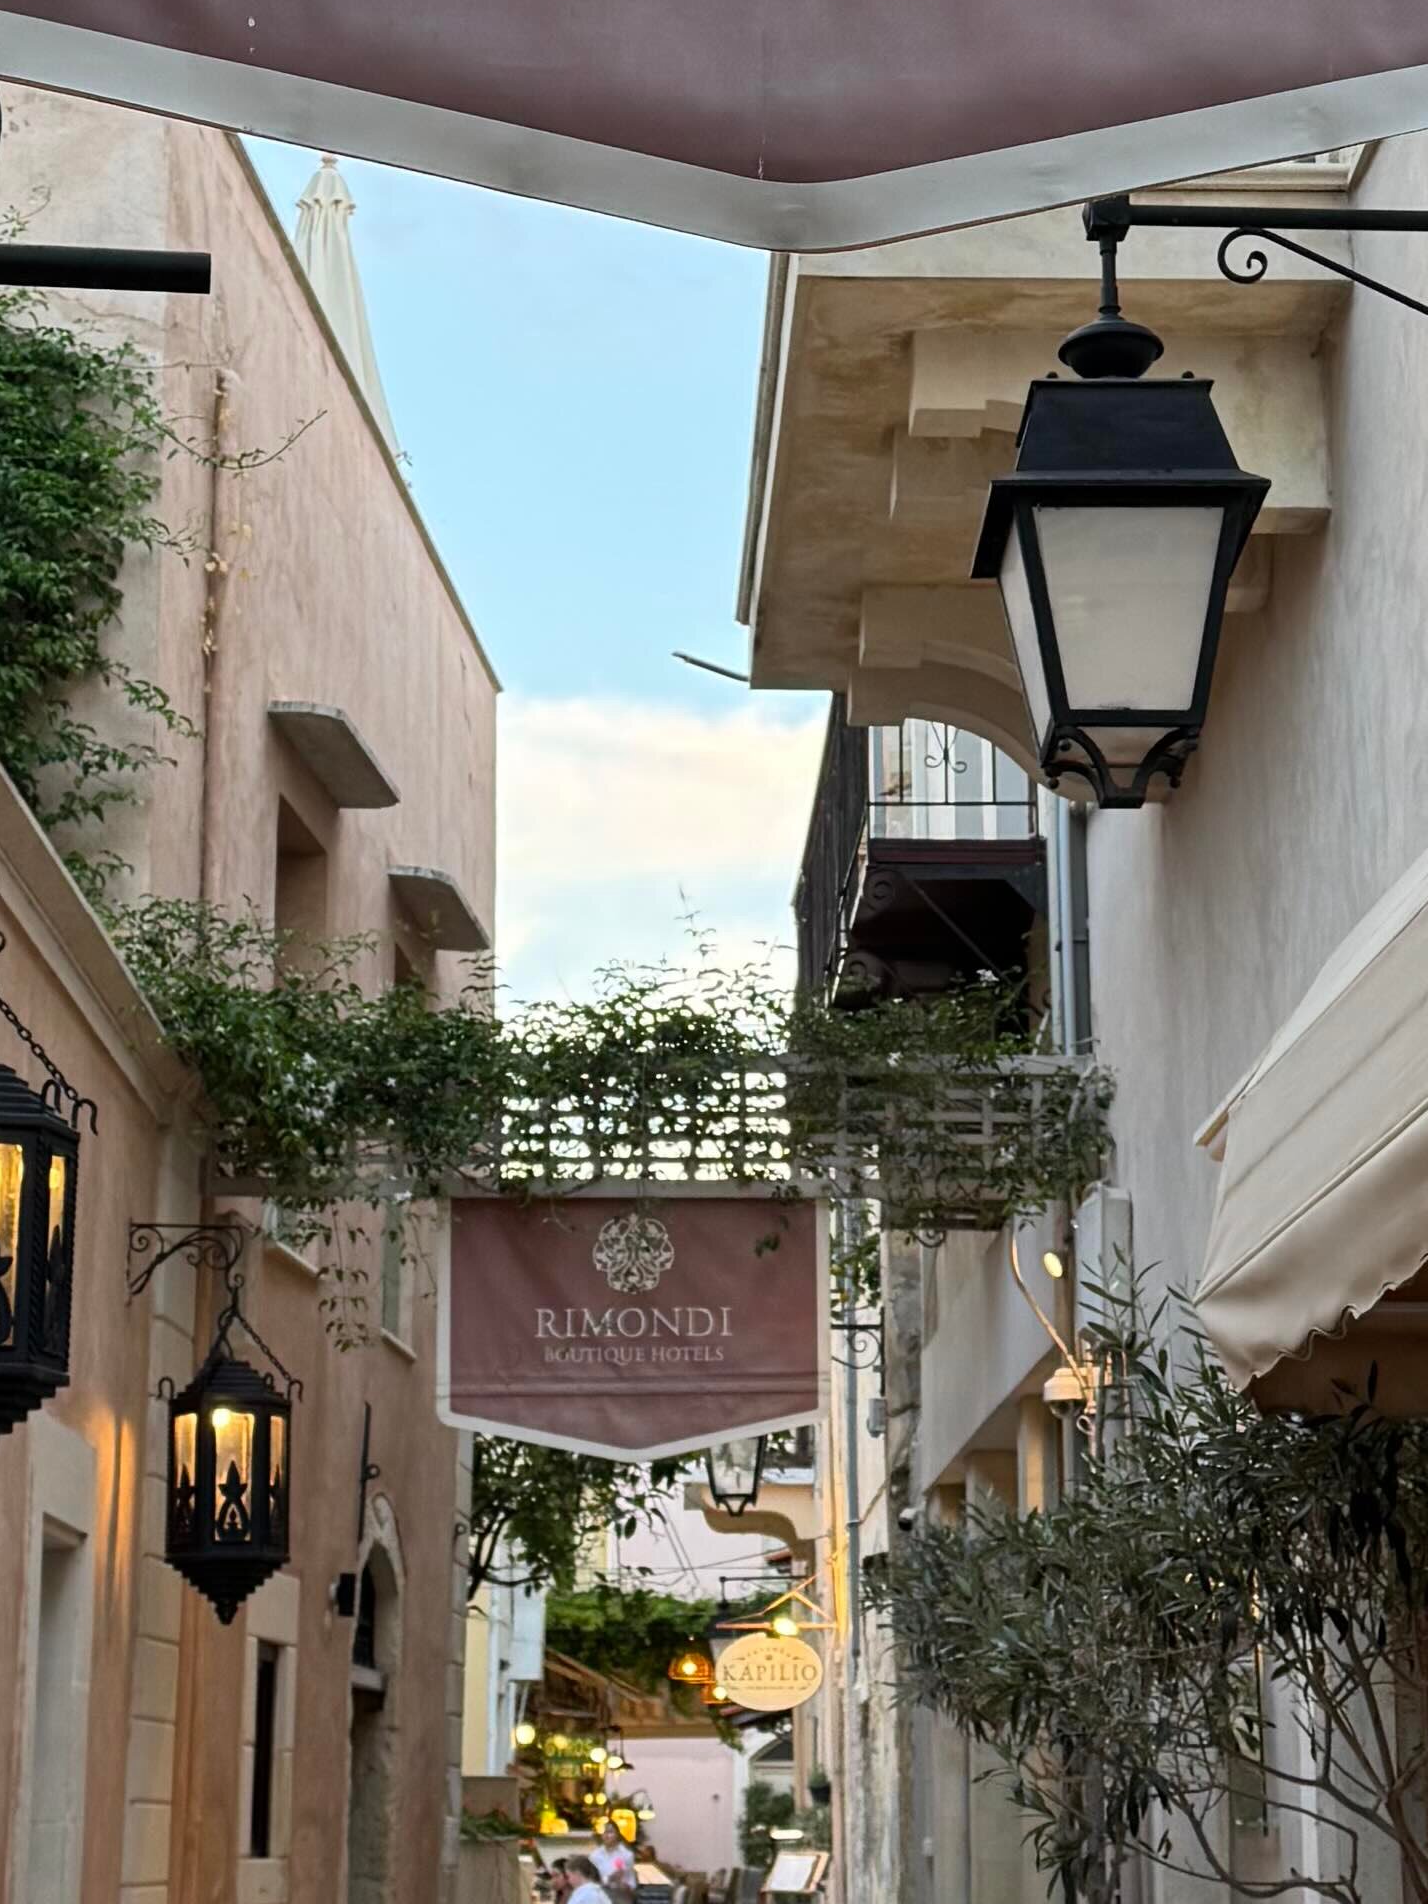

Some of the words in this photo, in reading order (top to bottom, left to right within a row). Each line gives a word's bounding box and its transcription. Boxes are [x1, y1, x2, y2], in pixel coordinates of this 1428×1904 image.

[535, 1307, 733, 1338] RIMONDI
[544, 1346, 645, 1364] BOUTIQUE
[651, 1345, 725, 1362] HOTELS
[723, 1663, 817, 1681] KAPILIO
